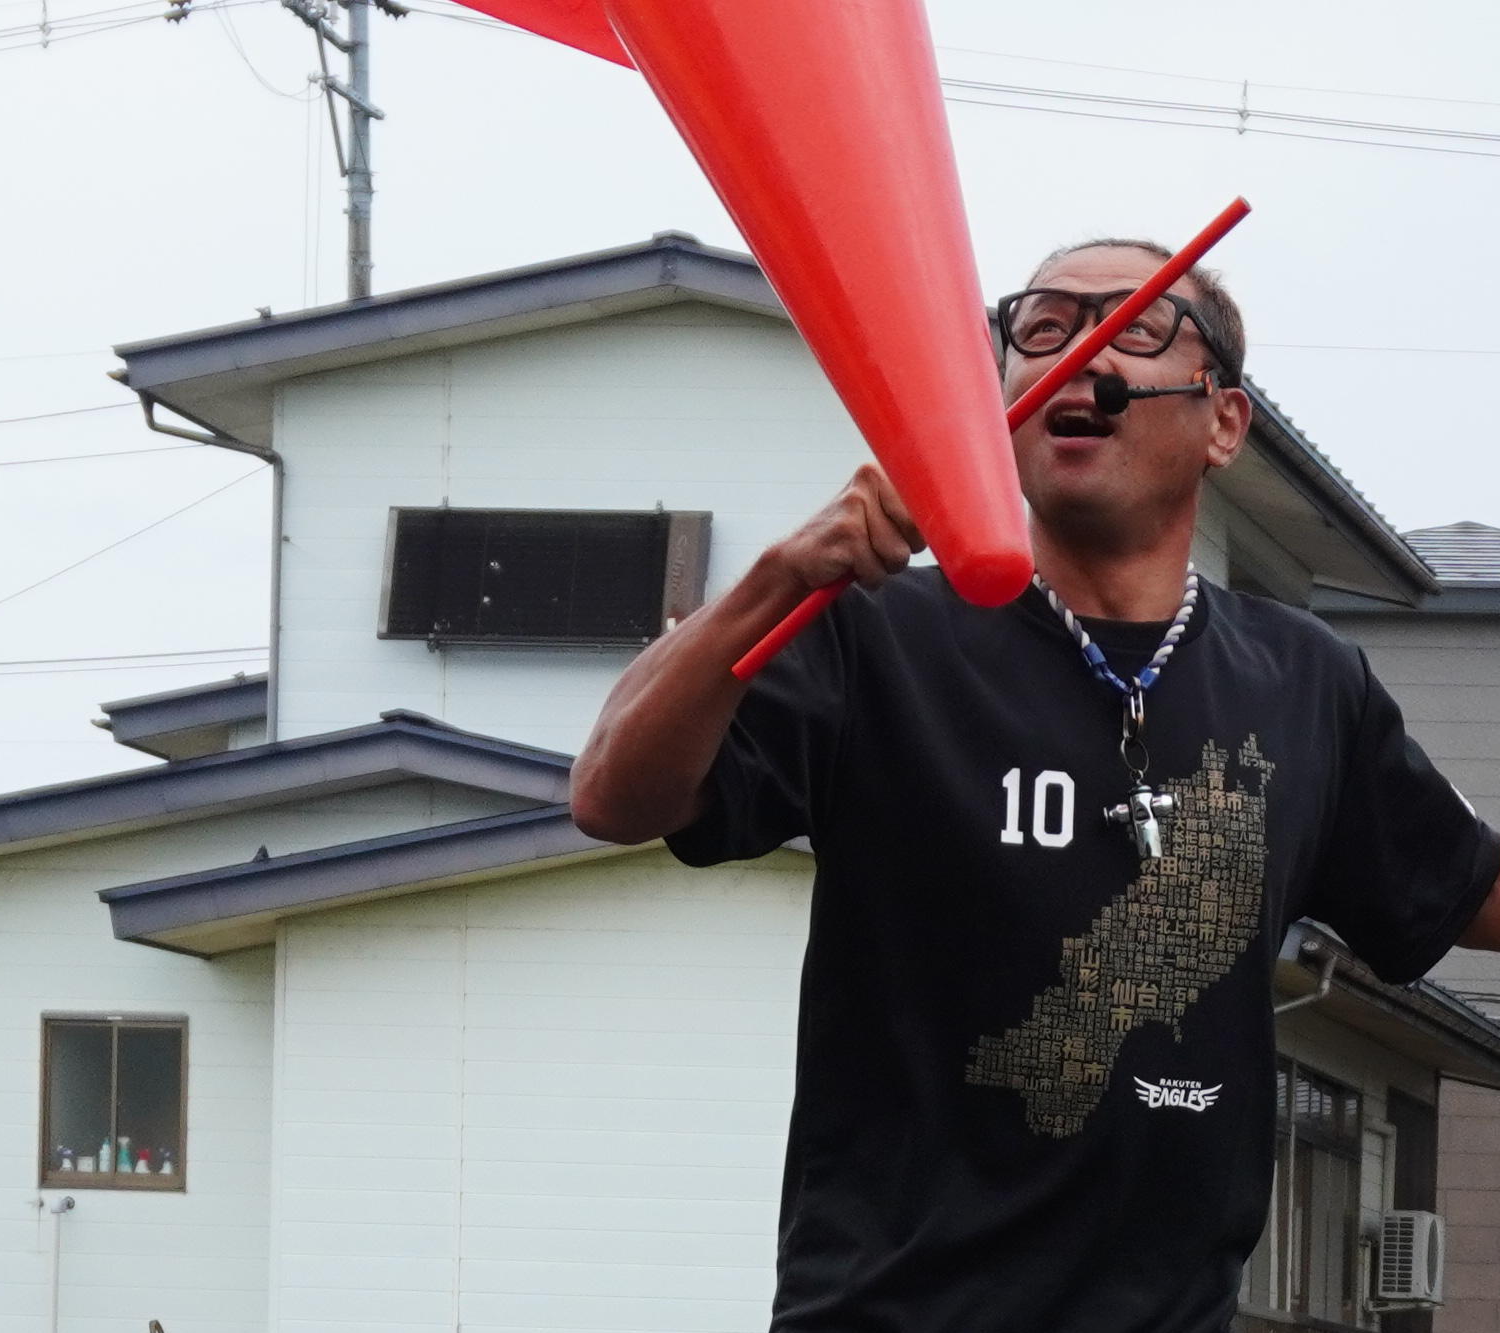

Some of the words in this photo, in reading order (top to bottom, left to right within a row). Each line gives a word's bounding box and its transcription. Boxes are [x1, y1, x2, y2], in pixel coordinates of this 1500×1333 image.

[1001, 767, 1075, 848] 10
[1160, 1078, 1201, 1089] RAKUTEN
[1147, 1086, 1207, 1112] EAGLES
